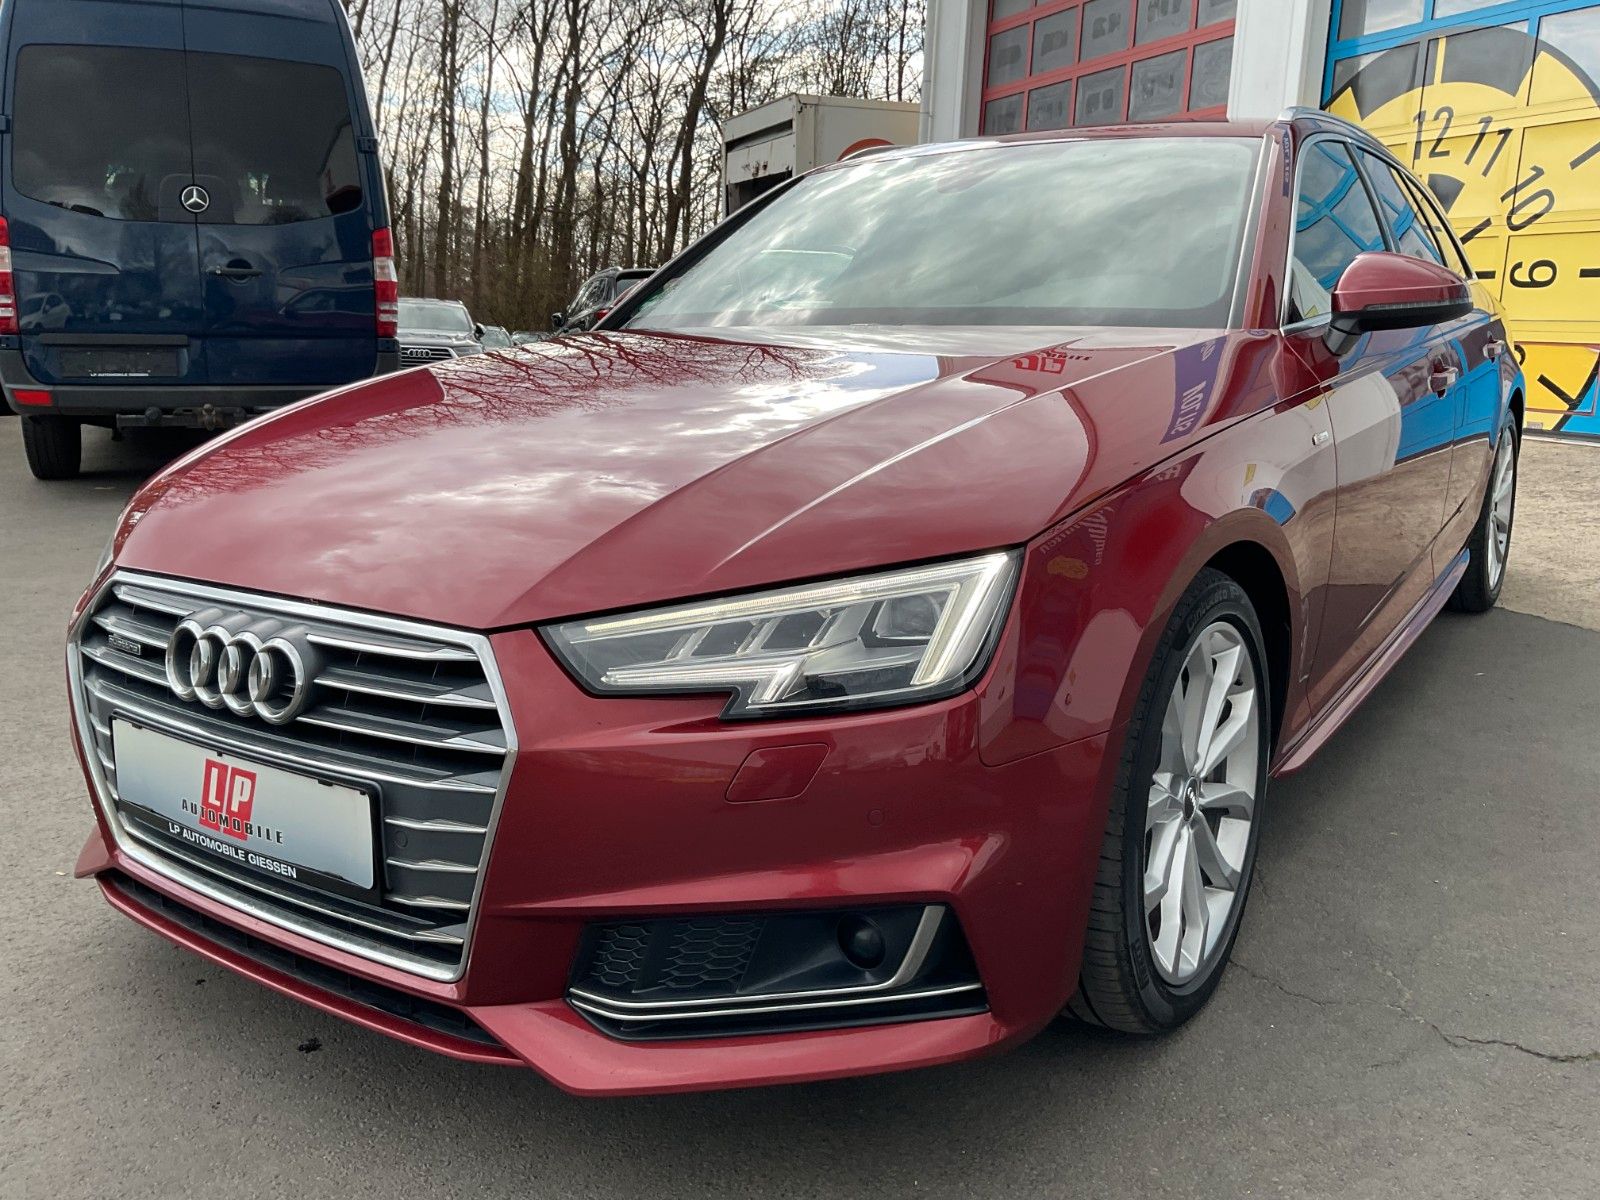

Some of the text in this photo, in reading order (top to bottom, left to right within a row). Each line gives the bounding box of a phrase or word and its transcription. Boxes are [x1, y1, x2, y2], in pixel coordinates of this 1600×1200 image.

[1413, 105, 1454, 161] 12
[1464, 115, 1514, 178] 11
[1500, 165, 1555, 232] 10
[208, 766, 252, 813] LP
[168, 821, 297, 879] LP AUTOMOBILE GIESSEN
[182, 798, 284, 845] AUTOMOBILE
